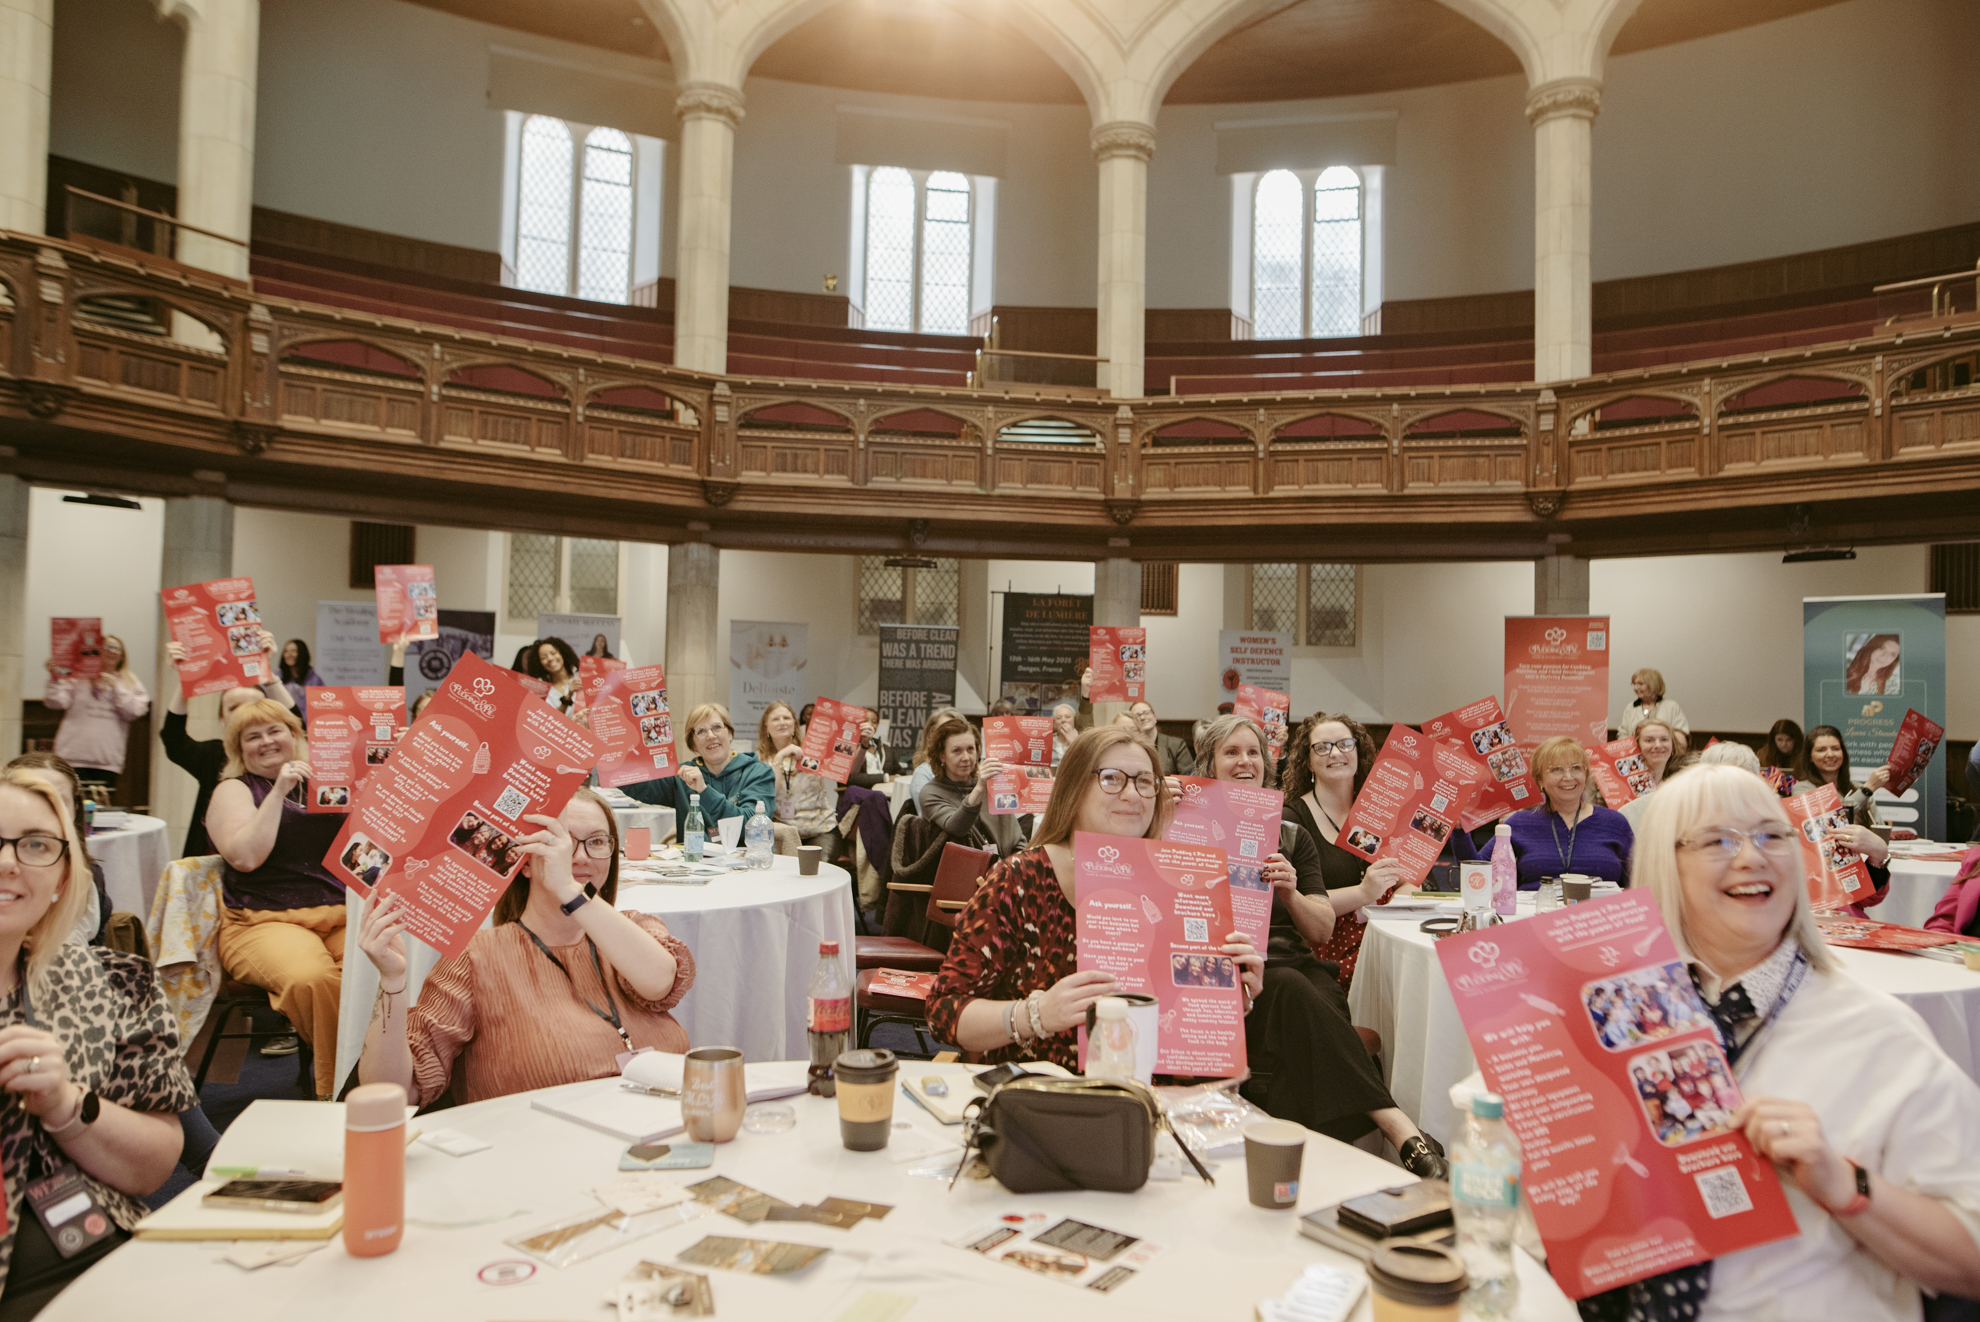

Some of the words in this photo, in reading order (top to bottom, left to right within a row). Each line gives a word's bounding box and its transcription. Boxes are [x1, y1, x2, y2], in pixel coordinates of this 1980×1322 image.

[1033, 598, 1045, 607] LA
[1048, 597, 1080, 608] FORÊT
[1026, 610, 1040, 618] DE
[1042, 609, 1088, 620] LUMIÈRE
[896, 628, 928, 640] BEFORE
[930, 630, 957, 642] CLEAN
[1240, 636, 1276, 645] WOMEN'S
[882, 642, 906, 658] WAS
[909, 643, 917, 658] A
[920, 644, 956, 659] TREND
[1250, 648, 1284, 656] DEFENCE
[882, 658, 904, 669] THERE
[905, 659, 920, 669] WAS
[922, 660, 956, 670] ARBONNE
[1232, 657, 1281, 666] INSTRUCTOR
[880, 690, 928, 708] BEFORE
[880, 708, 926, 728] CLEAN
[428, 719, 442, 732] Ask
[439, 729, 470, 751] yourself...
[526, 709, 544, 723] inspire
[544, 721, 554, 729] the
[553, 728, 566, 738] next
[565, 736, 594, 757] generation
[535, 708, 547, 717] Join
[546, 714, 568, 733] Pudding
[571, 731, 581, 740] Pie
[581, 739, 593, 748] and
[1844, 726, 1866, 736] Laura
[417, 730, 432, 742] Would
[438, 745, 449, 754] love
[526, 717, 538, 726] with
[538, 724, 548, 733] the
[546, 730, 565, 746] power
[564, 740, 573, 749] of
[571, 747, 588, 759] food!
[412, 736, 424, 744] your
[432, 748, 452, 763] business
[450, 760, 460, 769] but
[412, 740, 424, 750] don't
[423, 748, 436, 758] know
[435, 757, 449, 768] where
[422, 754, 438, 766] start?
[397, 758, 417, 773] childrens
[416, 771, 442, 789] well-being?
[411, 759, 422, 770] have
[424, 771, 442, 784] passion
[511, 761, 550, 789] information?
[519, 758, 535, 772] Want
[534, 770, 551, 782] more
[387, 764, 399, 774] Have
[414, 783, 424, 792] fire
[426, 794, 439, 802] your
[393, 775, 405, 786] belly
[409, 787, 422, 797] make
[502, 771, 529, 792] brochure
[528, 789, 544, 802] here
[506, 766, 536, 788] Download
[534, 787, 546, 795] our
[393, 782, 419, 801] difference?
[472, 799, 492, 815] Become
[489, 813, 503, 823] part
[508, 824, 518, 833] the
[1171, 848, 1192, 856] Pudding
[1088, 899, 1102, 907] Ask
[1173, 897, 1211, 906] information?
[1174, 902, 1202, 911] Download
[1173, 908, 1200, 916] brochure
